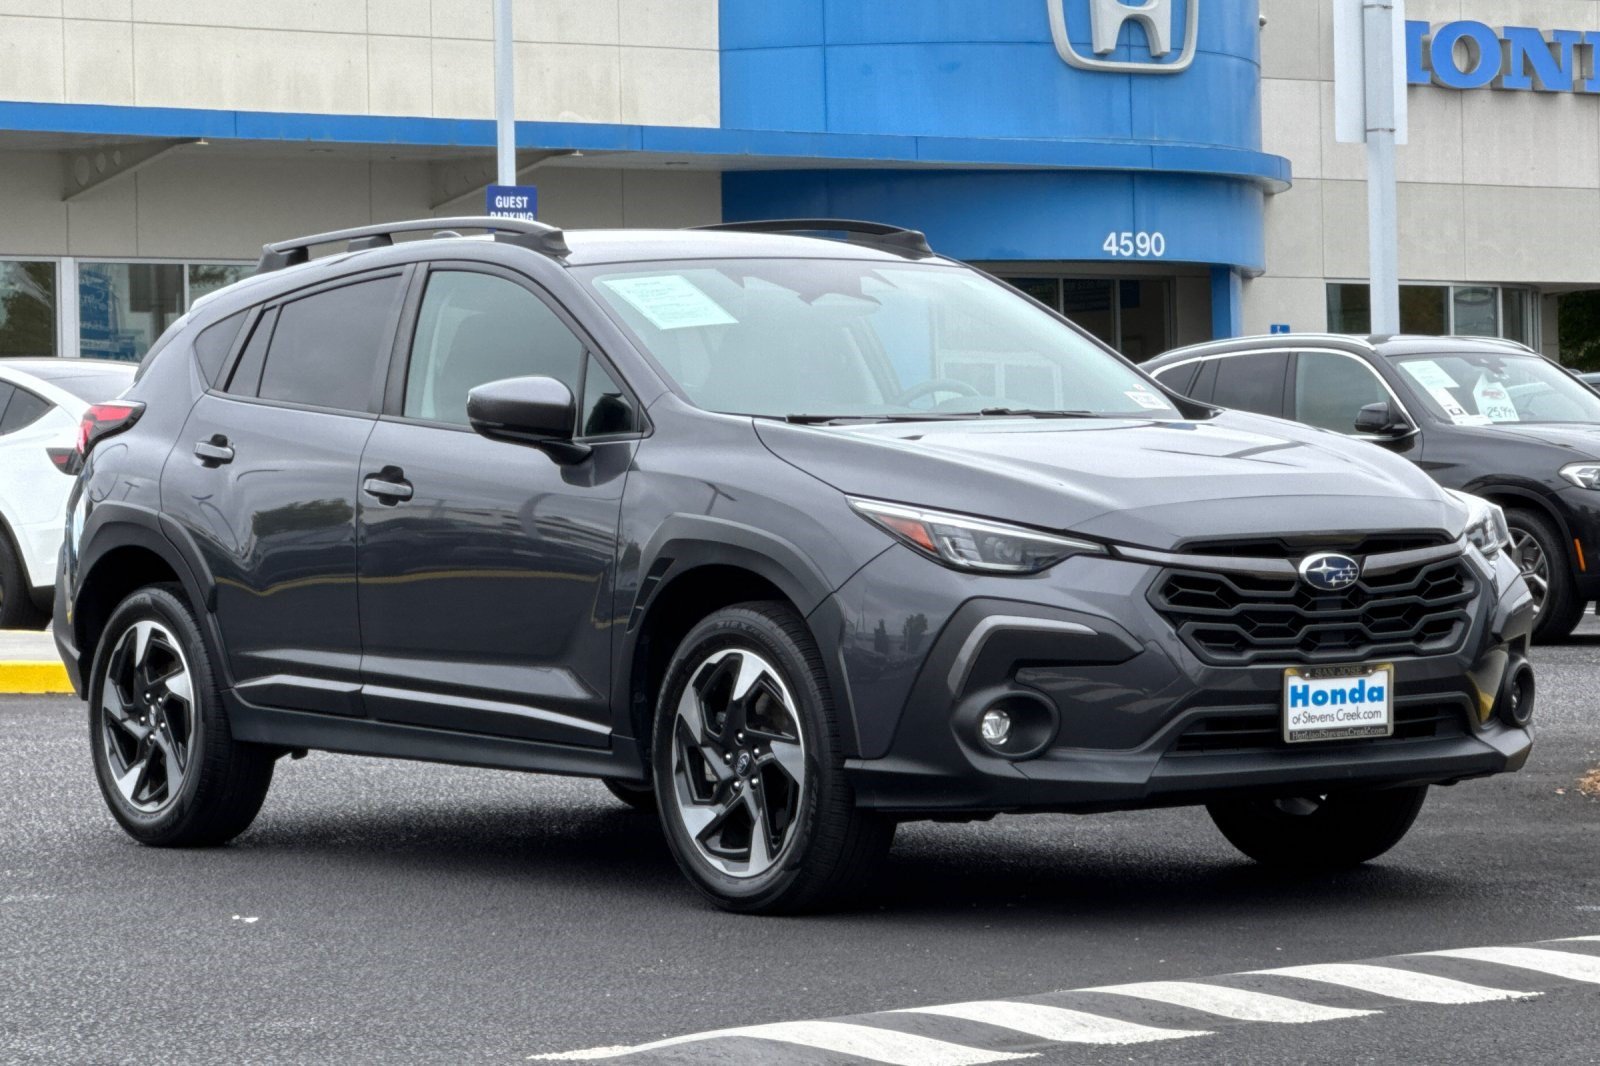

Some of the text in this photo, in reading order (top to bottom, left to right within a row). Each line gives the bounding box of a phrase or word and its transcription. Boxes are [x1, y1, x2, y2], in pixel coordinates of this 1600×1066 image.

[1405, 20, 1600, 92] ON
[495, 195, 529, 209] GUEST
[1103, 231, 1165, 257] 4590
[1290, 679, 1385, 708] Honda
[1292, 706, 1382, 725] of Stevens Creek.com
